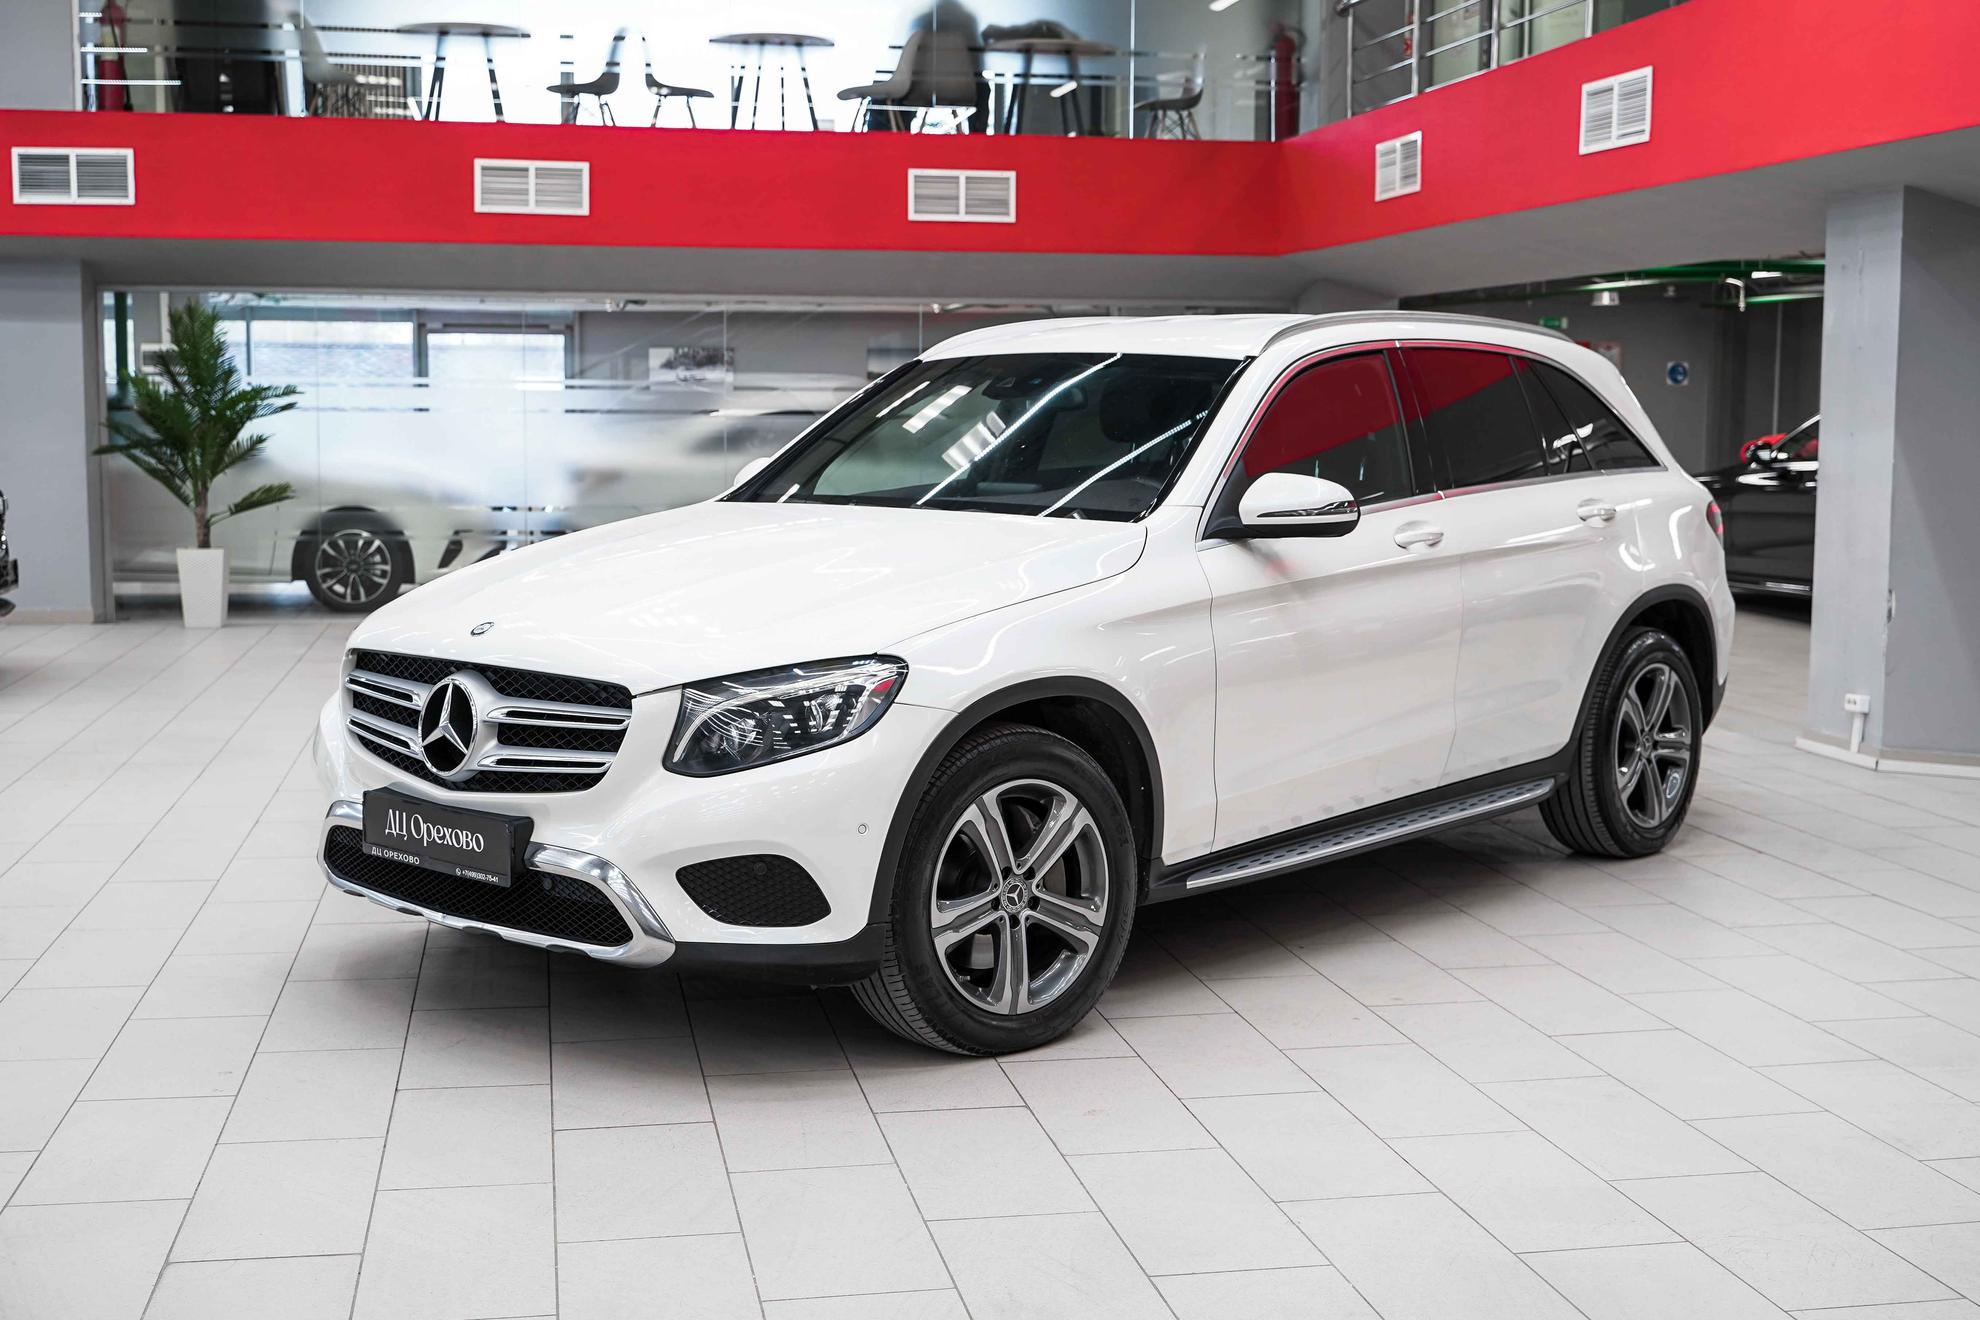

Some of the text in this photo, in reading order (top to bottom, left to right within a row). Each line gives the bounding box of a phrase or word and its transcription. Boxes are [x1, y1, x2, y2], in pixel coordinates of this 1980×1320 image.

[385, 808, 485, 853] ДЦ Орехово
[371, 846, 420, 865] ДЦ ОРЕХОВО
